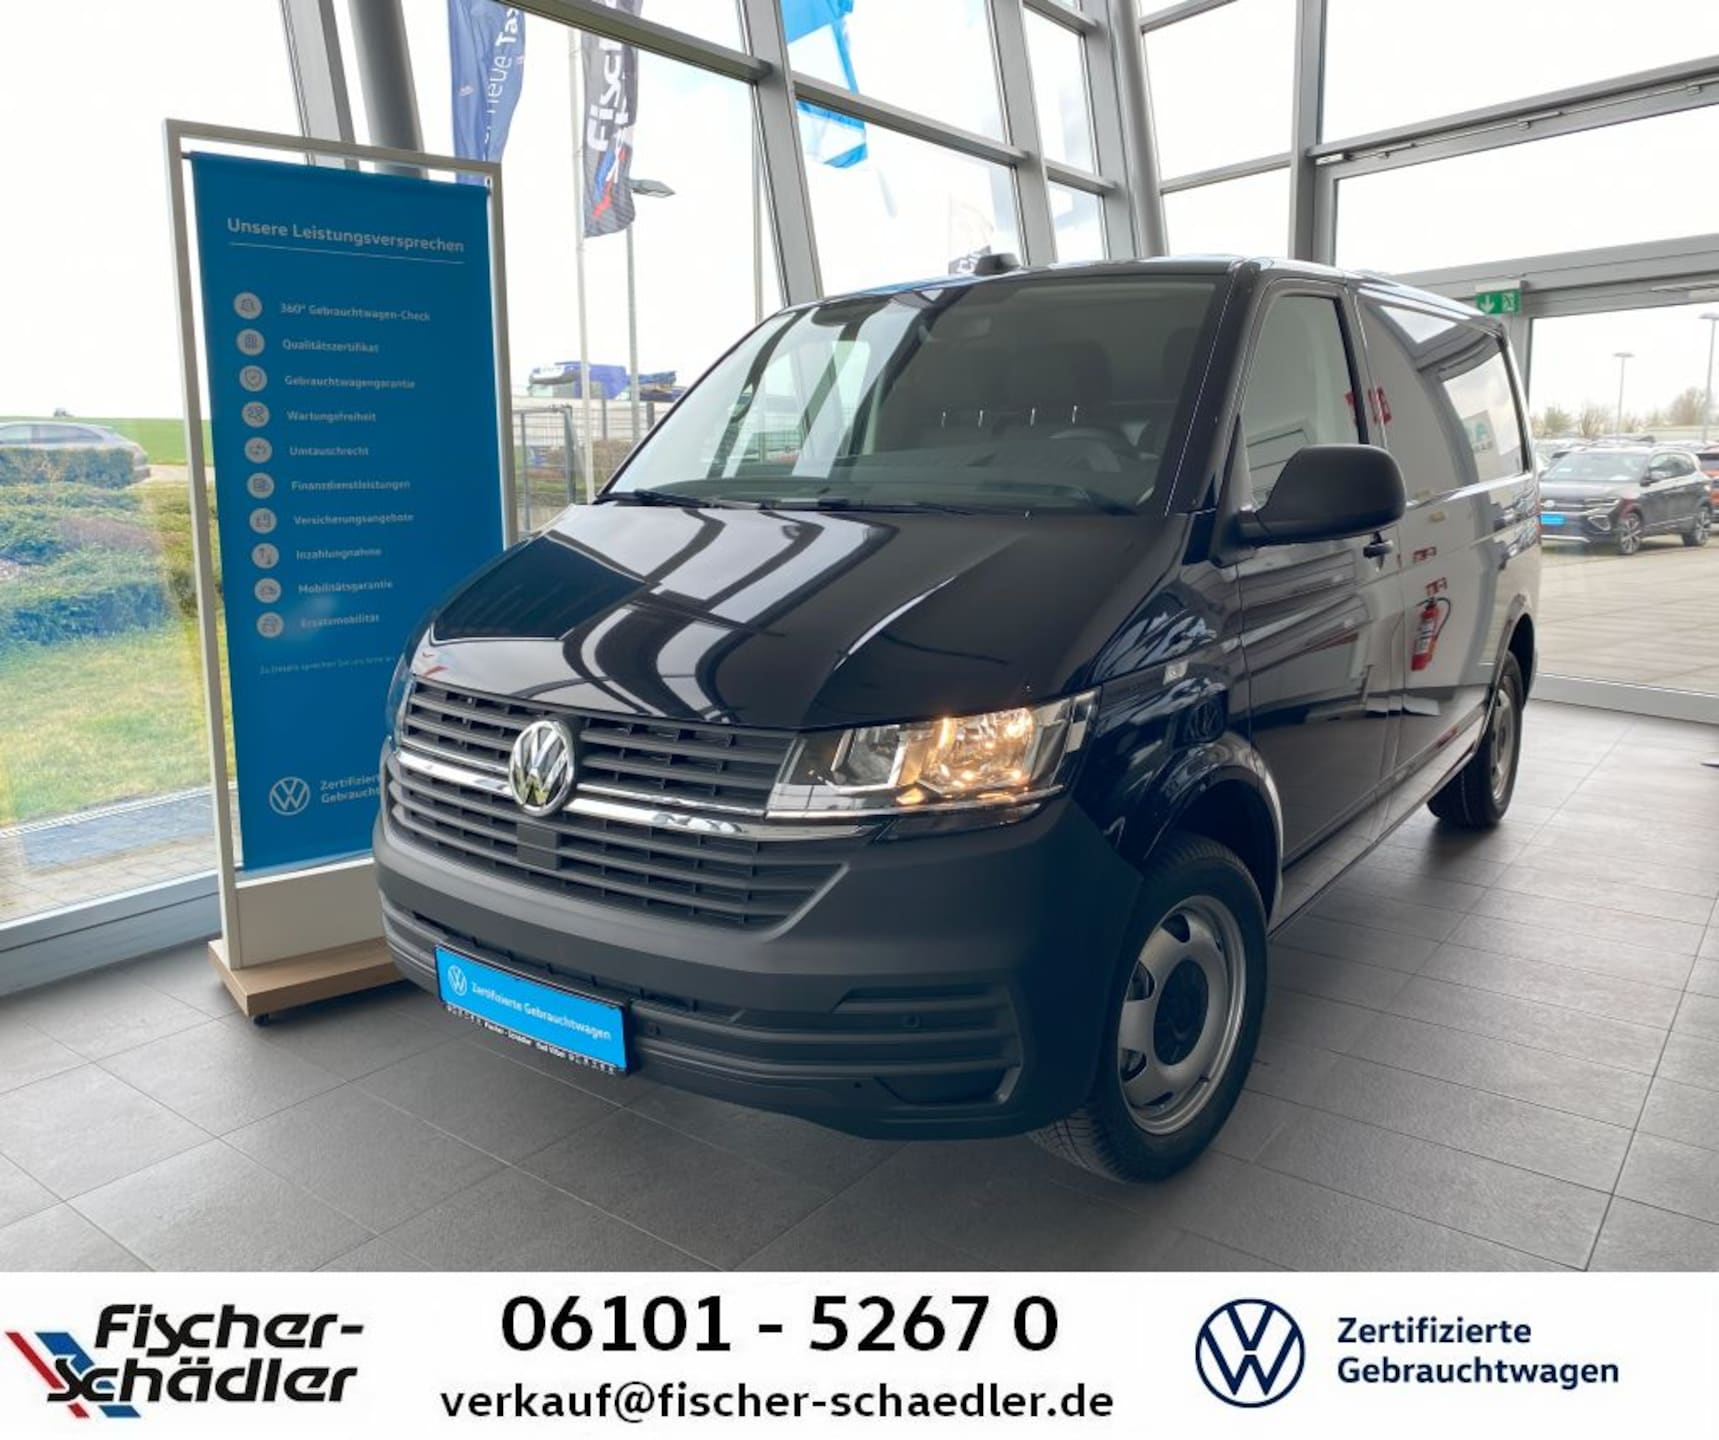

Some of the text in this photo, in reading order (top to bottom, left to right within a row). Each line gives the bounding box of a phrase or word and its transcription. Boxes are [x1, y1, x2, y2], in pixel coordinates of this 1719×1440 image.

[227, 217, 465, 254] Unsere Leistungsversprechen
[308, 303, 431, 322] Gebrauchtwagen-Check
[282, 337, 379, 354] Qualitätszertifikat
[284, 374, 416, 391] Gebrauchtwagengarantie
[286, 409, 377, 424] Wartungsfreiheit
[289, 444, 369, 457] Umtauschrecht
[291, 479, 411, 492] Finanzdienstleistungen
[293, 511, 415, 527] Versicherungsangebote
[296, 546, 383, 561] Inzahlungnahme
[298, 579, 394, 595] Mobilitätsgarantie
[471, 981, 612, 1040] Zertifizierte Gebrauchtwagen
